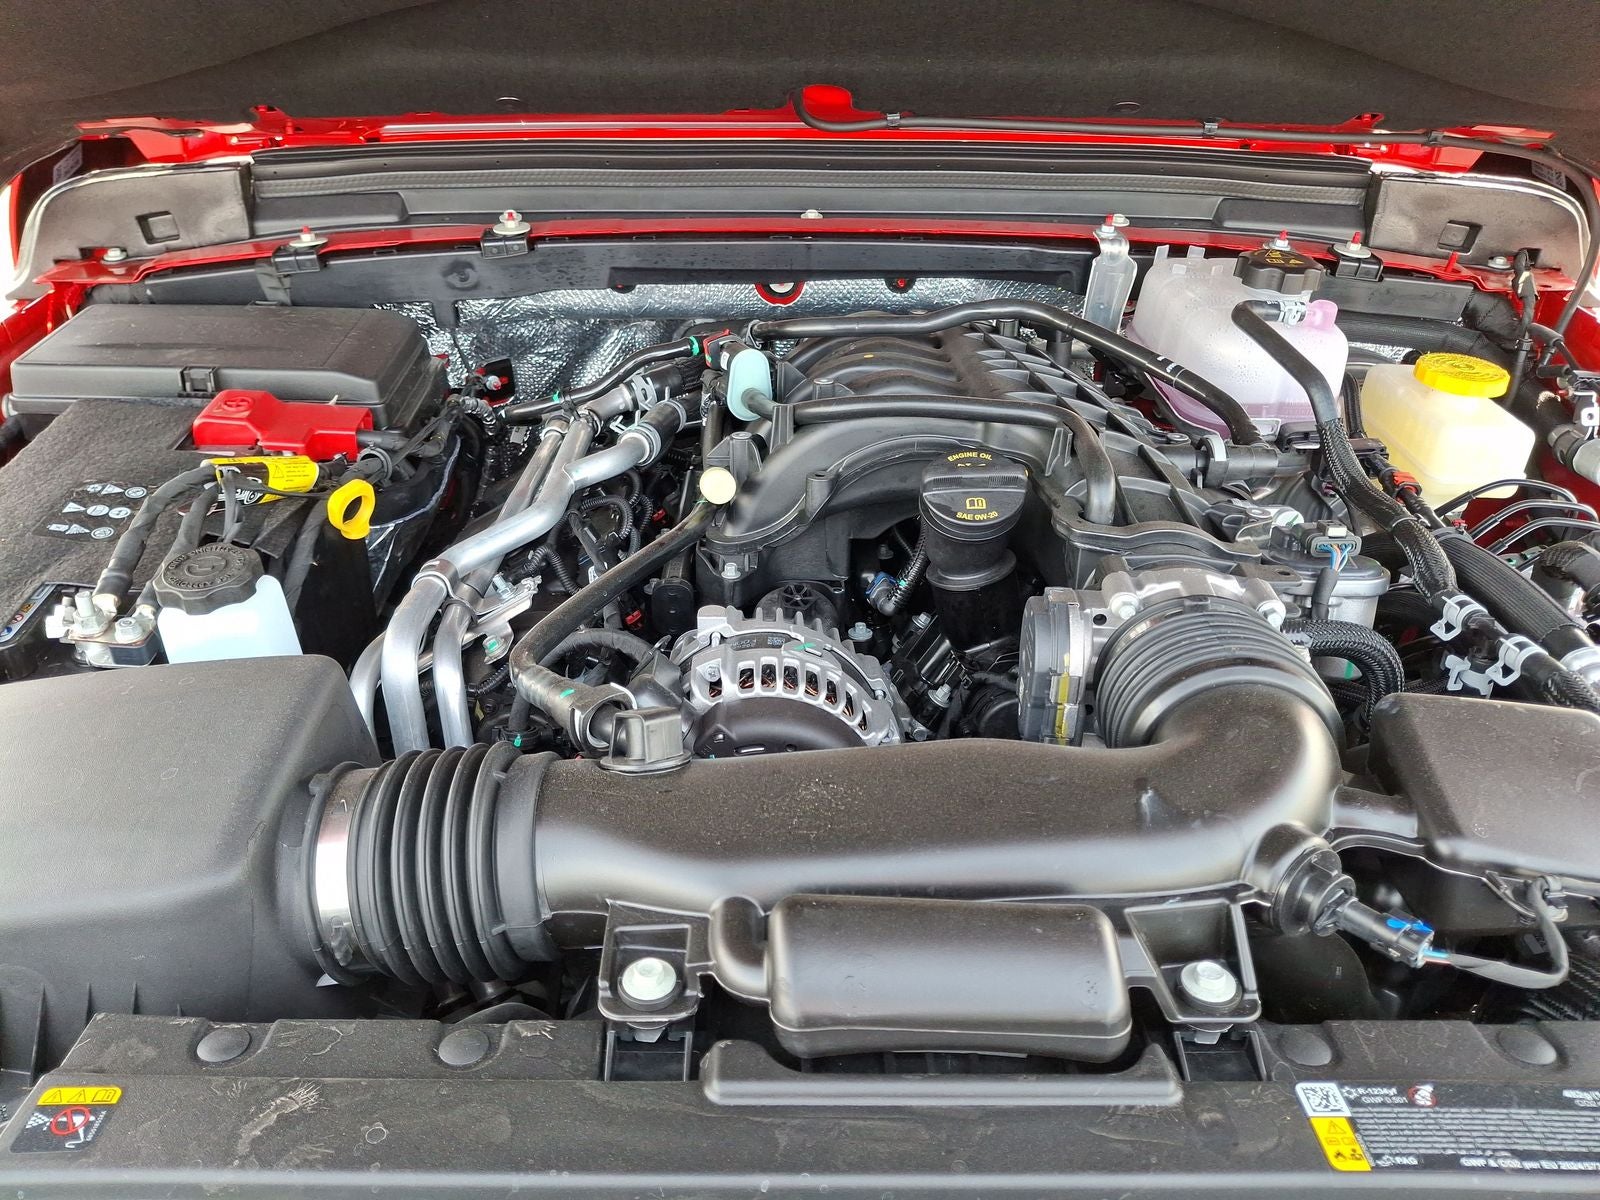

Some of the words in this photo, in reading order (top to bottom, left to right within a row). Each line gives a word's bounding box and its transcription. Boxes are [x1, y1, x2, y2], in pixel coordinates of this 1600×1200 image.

[947, 452, 978, 462] ENGINE
[979, 452, 993, 461] OIL
[956, 511, 974, 521] SAE
[974, 511, 998, 521] 0W-20
